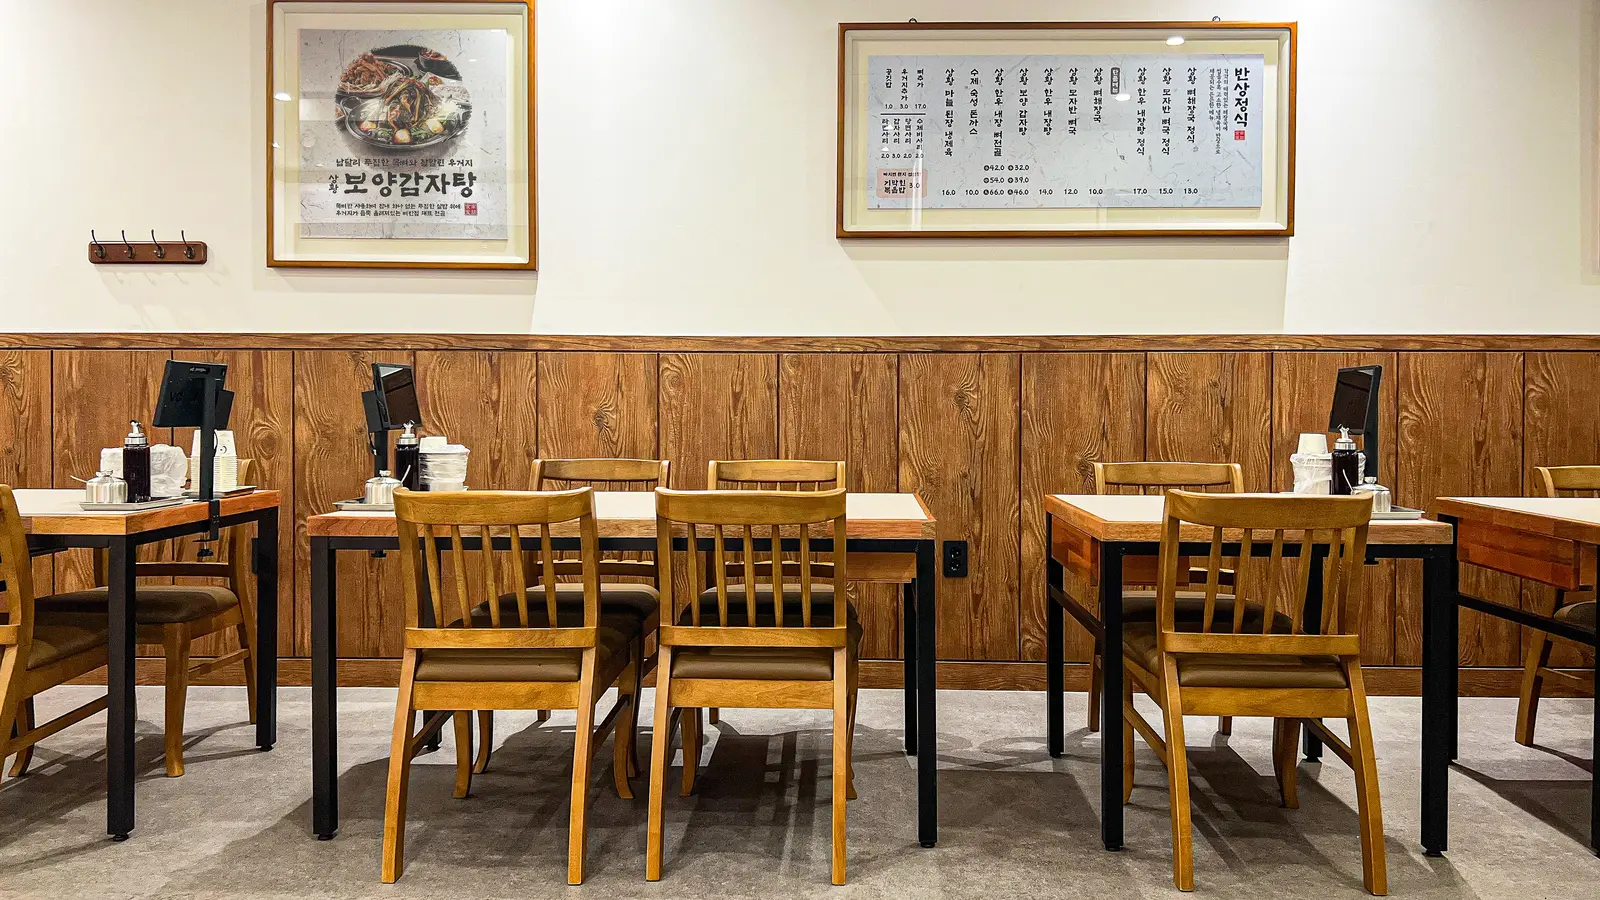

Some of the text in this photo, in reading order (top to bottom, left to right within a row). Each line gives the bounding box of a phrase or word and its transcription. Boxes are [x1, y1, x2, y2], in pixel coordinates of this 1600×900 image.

[944, 68, 955, 157] 상황 마늘 된장 냉제육
[969, 68, 979, 135] 수제 숙성 돈까스
[994, 68, 1004, 156] 상황 한우 내장 뼈전골
[1019, 68, 1029, 136] 상황 보양 감자탕
[1043, 68, 1053, 135] 상황 한우 내장탕
[1068, 67, 1078, 135] 상황 모자반 뼈국
[1093, 67, 1103, 123] 상황 뼈해장국
[1137, 67, 1147, 156] 상황 한우 내장탕 정식
[1162, 67, 1172, 155] 상황 모자반 뼈국 정식
[1187, 67, 1197, 144] 상황 뼈해장국 정식
[1234, 67, 1250, 127] 반상정식
[329, 174, 339, 194] 상황
[336, 158, 360, 167] 남달리
[364, 159, 389, 167] 푸짐한
[448, 159, 472, 167] 우거지
[344, 172, 477, 198] 보양감자탕
